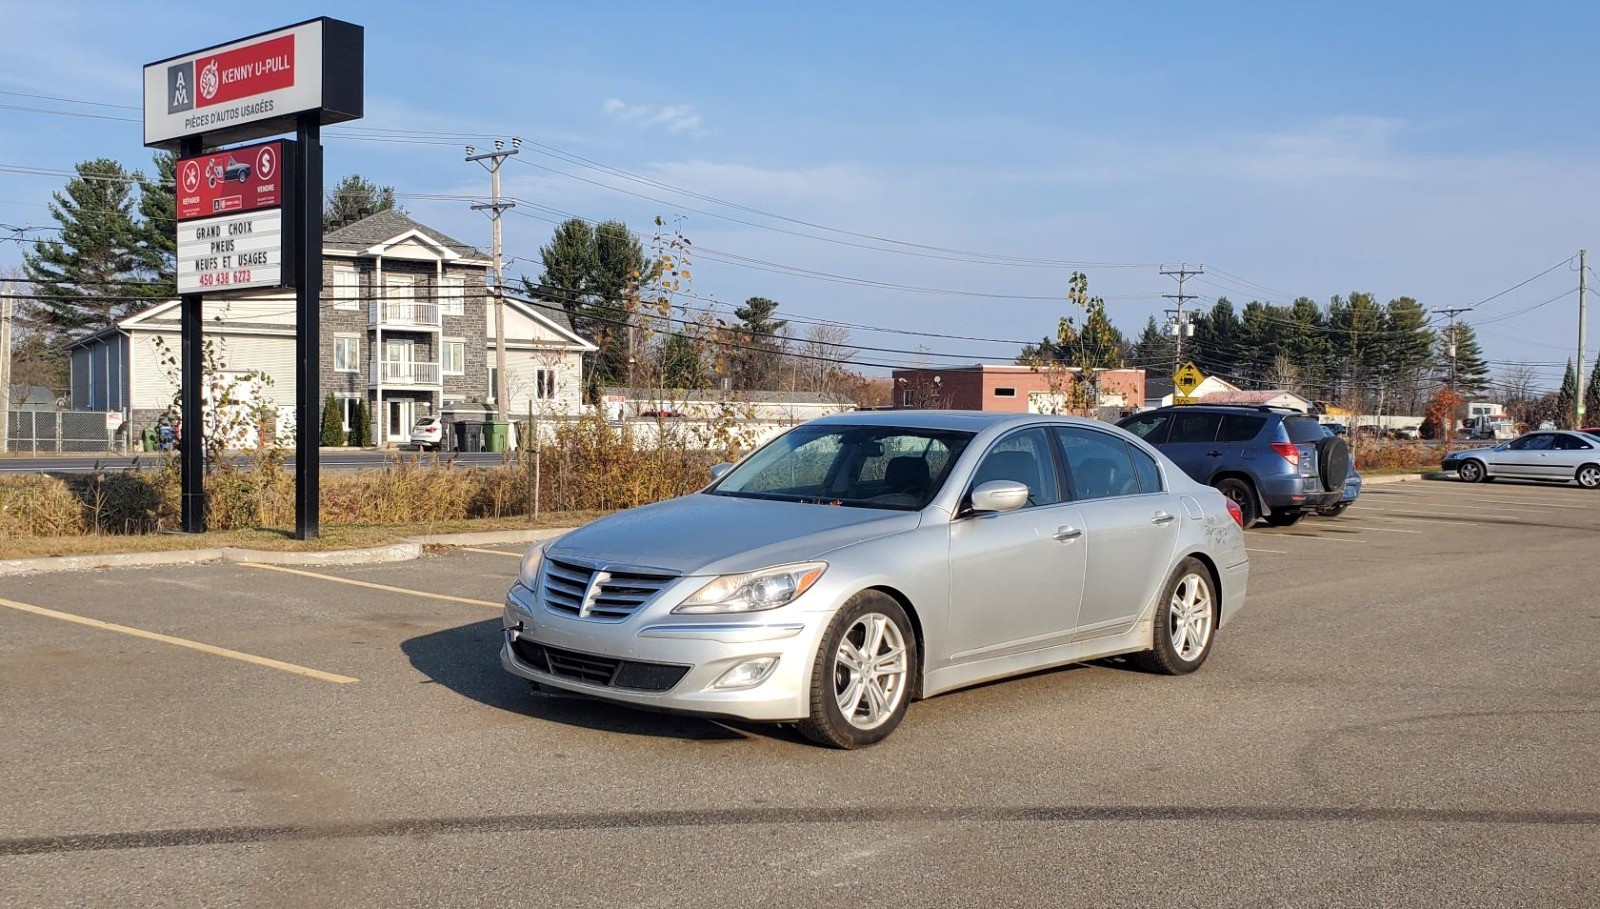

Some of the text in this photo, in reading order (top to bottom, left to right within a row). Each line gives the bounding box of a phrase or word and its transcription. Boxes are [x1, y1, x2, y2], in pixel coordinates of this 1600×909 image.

[222, 55, 290, 85] KENNY U-PULL
[185, 99, 274, 129] PIÈCES D'AUTOS USAGÉES
[196, 221, 253, 240] GRAND CHOIX
[210, 239, 235, 254] PNEUS
[195, 252, 268, 271] NEUFS ET USAGES
[199, 274, 214, 285] 450
[233, 270, 251, 283] 6273
